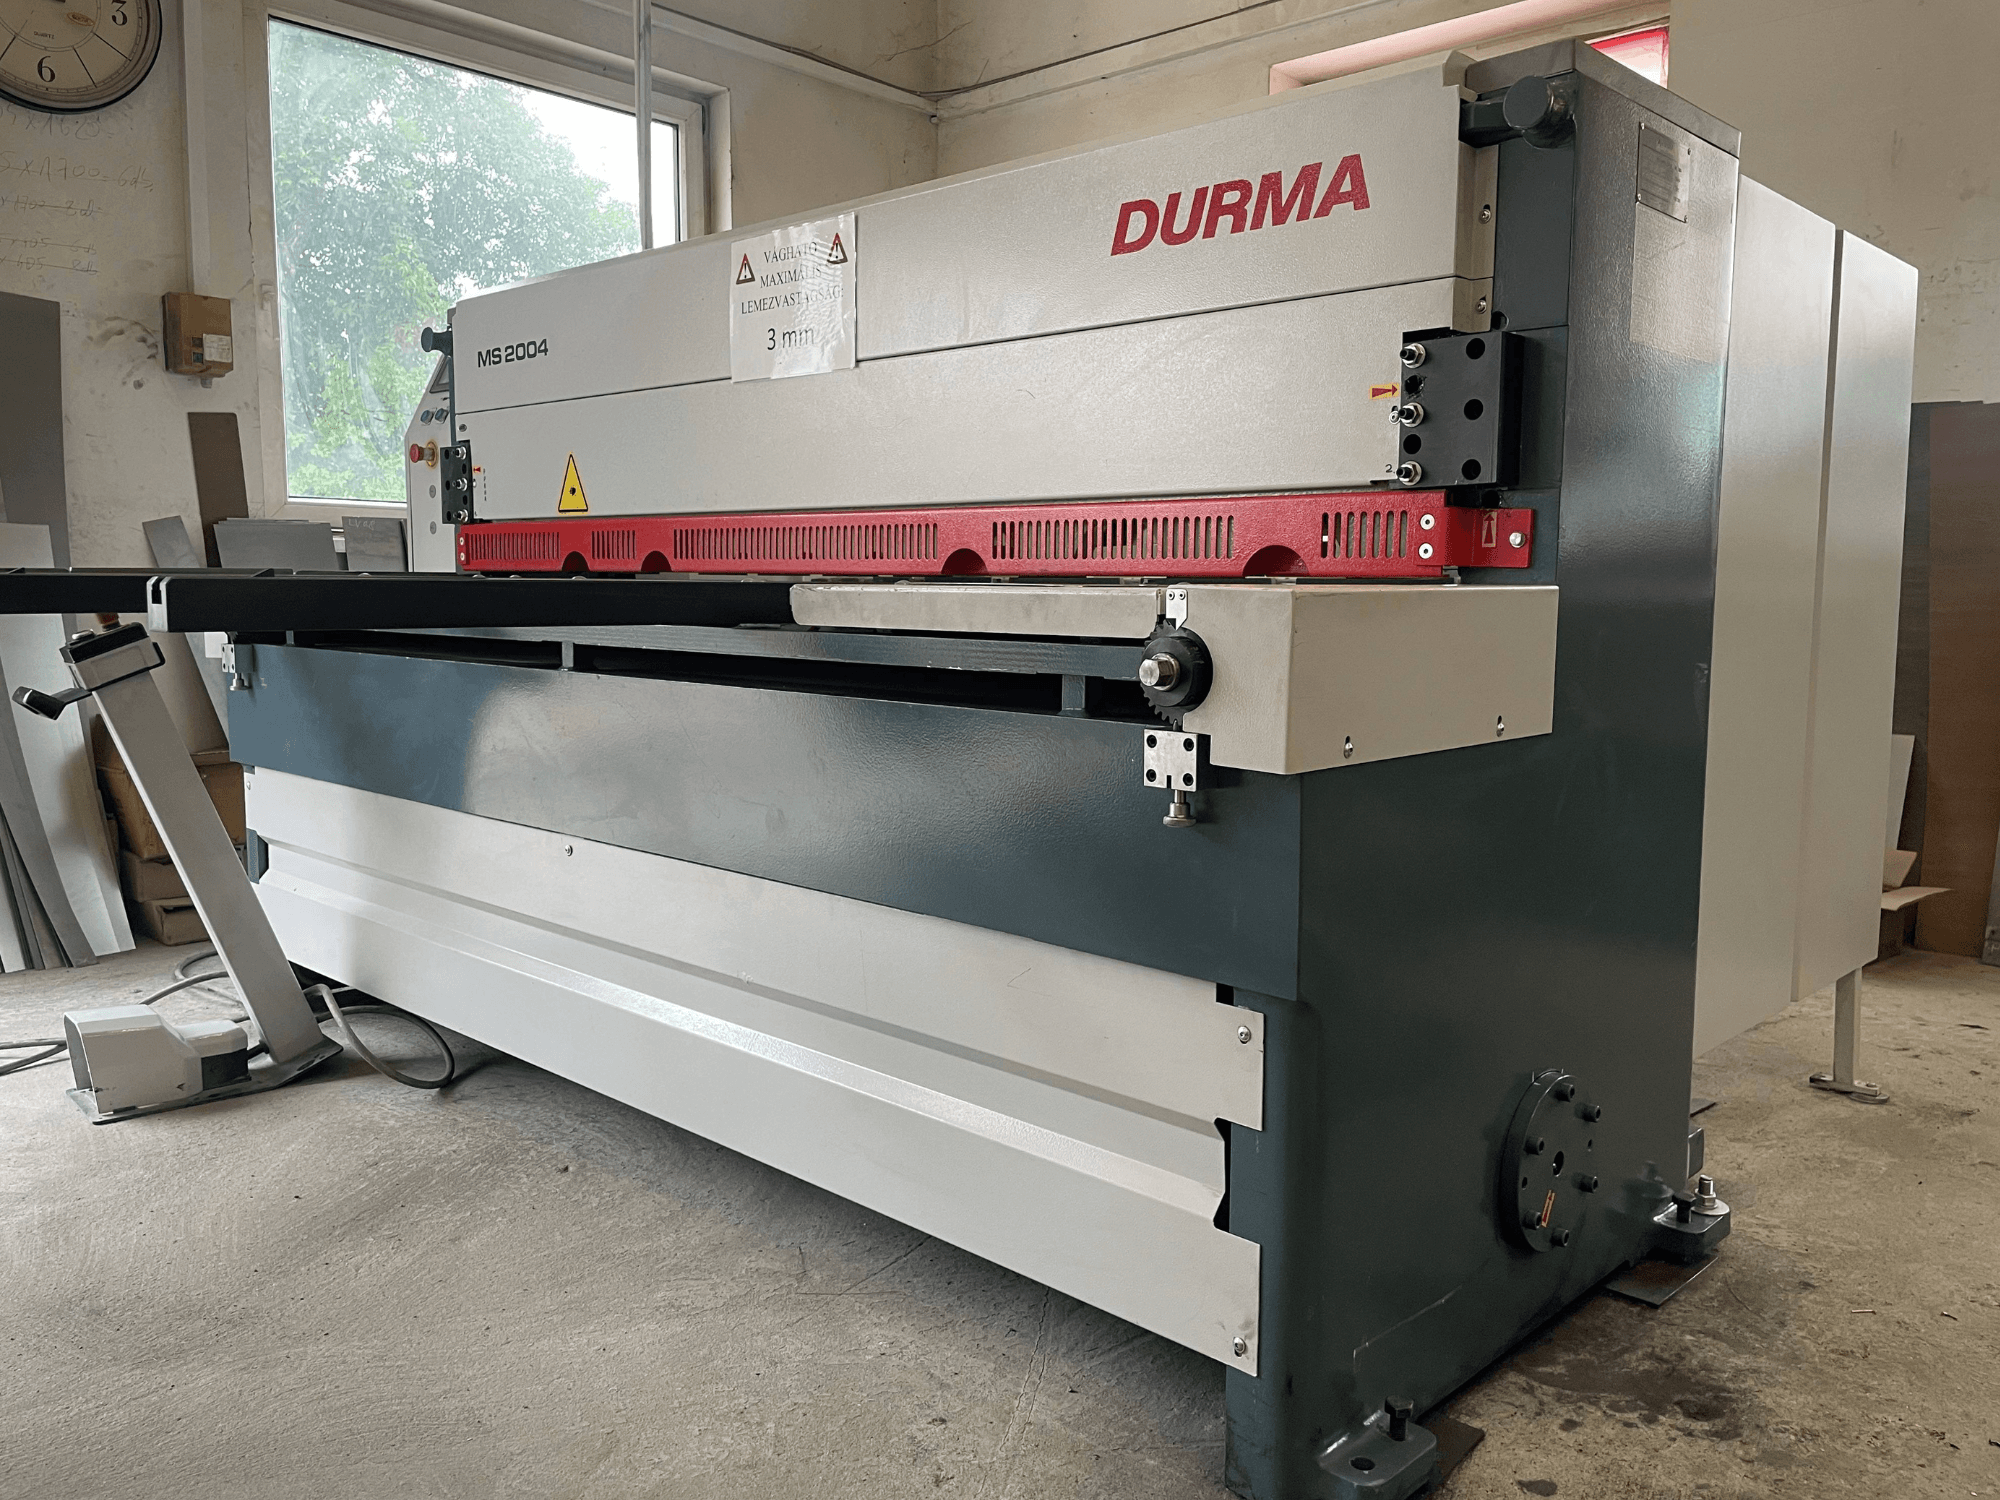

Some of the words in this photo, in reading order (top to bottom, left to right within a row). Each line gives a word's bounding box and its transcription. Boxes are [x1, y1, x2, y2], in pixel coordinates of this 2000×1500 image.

[111, 0, 128, 26] 3
[37, 55, 56, 83] 6
[1110, 153, 1371, 256] DURMA
[767, 328, 776, 350] 3
[782, 327, 815, 348] mm
[477, 347, 502, 368] MS
[504, 338, 549, 363] 2004
